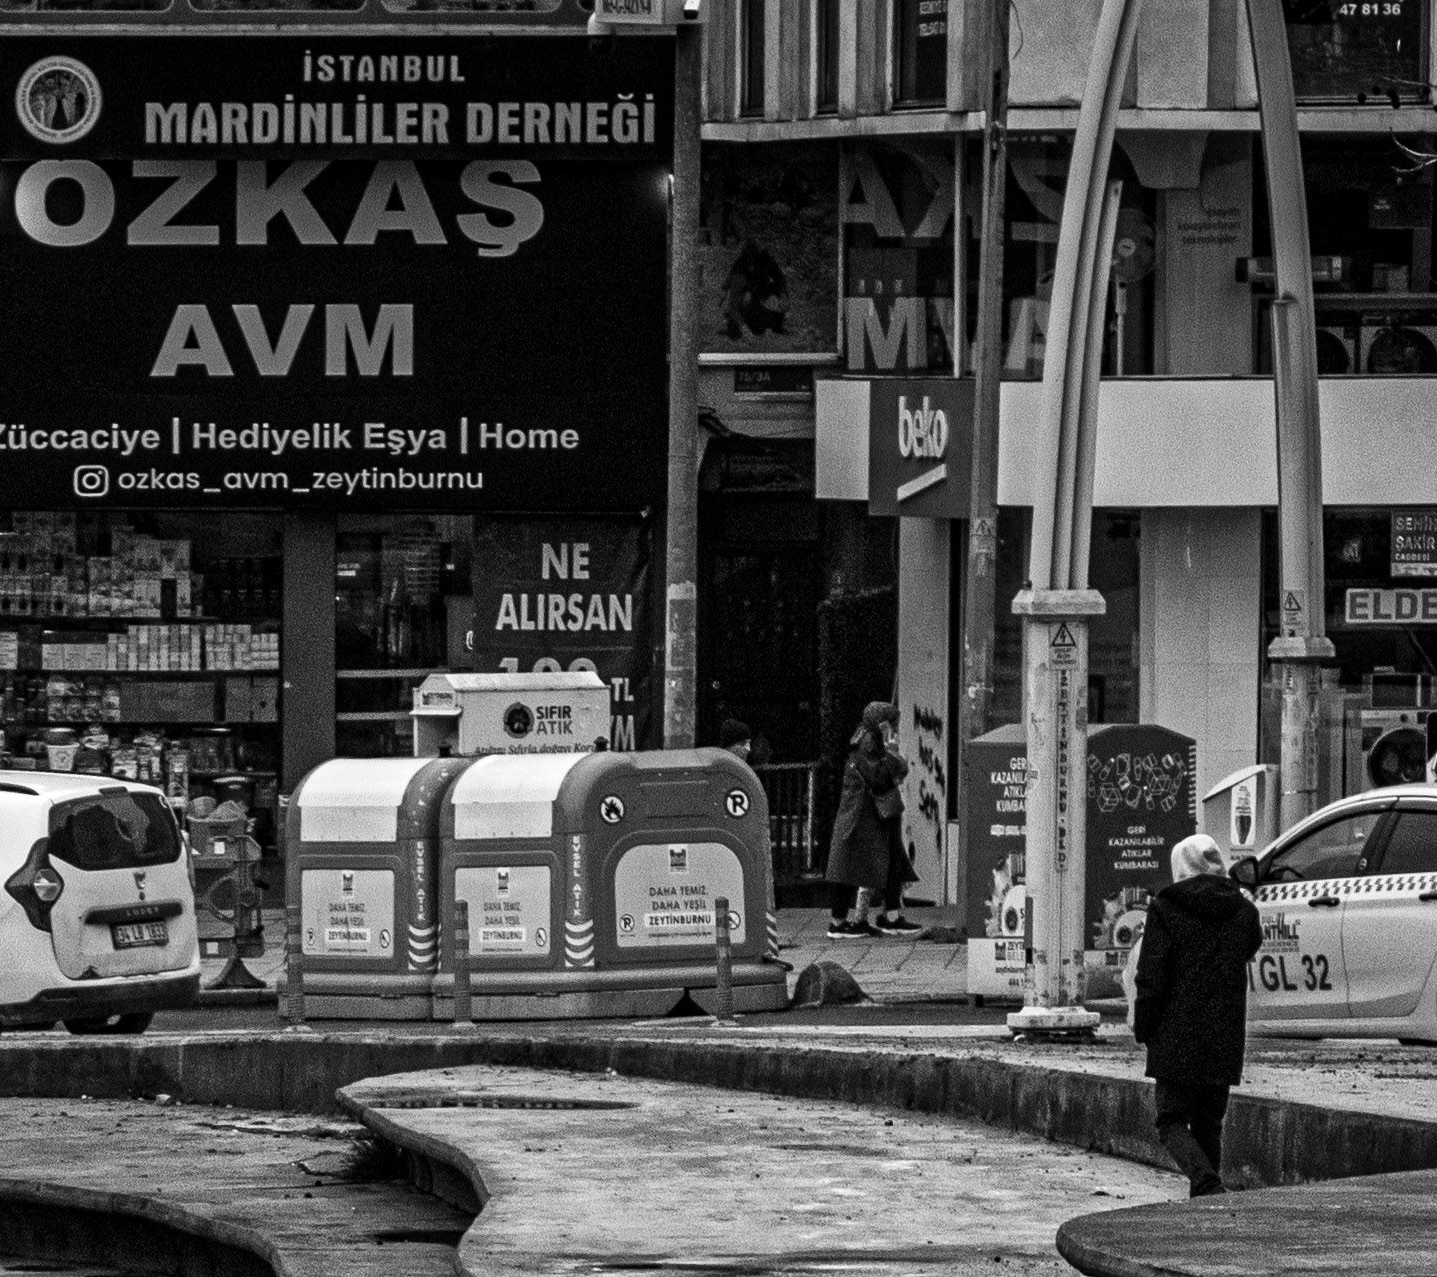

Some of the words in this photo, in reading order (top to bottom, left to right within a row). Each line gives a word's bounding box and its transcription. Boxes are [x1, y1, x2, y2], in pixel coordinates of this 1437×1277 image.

[1382, 3, 1402, 15] 36
[302, 49, 467, 84] İSTANBUL
[144, 94, 450, 145] MARDİNLİLER
[465, 93, 655, 145] DERNEĞİ
[149, 303, 415, 378] AVM
[192, 420, 352, 456] Hediyelik
[362, 422, 447, 456] Eşya
[478, 421, 580, 451] Home
[898, 396, 948, 457] beko
[116, 467, 484, 497] ozkas_avm_zeytinburnu
[1395, 534, 1436, 553] ŞAKİR
[541, 542, 590, 580] NE
[495, 593, 632, 632] ALIRSAN
[611, 677, 635, 702] TL
[536, 705, 572, 720] SIFIR
[536, 721, 574, 735] ATIK
[415, 841, 426, 882] EVSEL
[572, 835, 582, 878] EVSEL
[571, 884, 583, 917] ATIK
[649, 887, 677, 898] DAHA
[652, 900, 680, 911] DAHA
[683, 899, 707, 911] YEŞİL
[648, 914, 712, 926] ZEYTİNBURNU
[1302, 954, 1333, 992] 32
